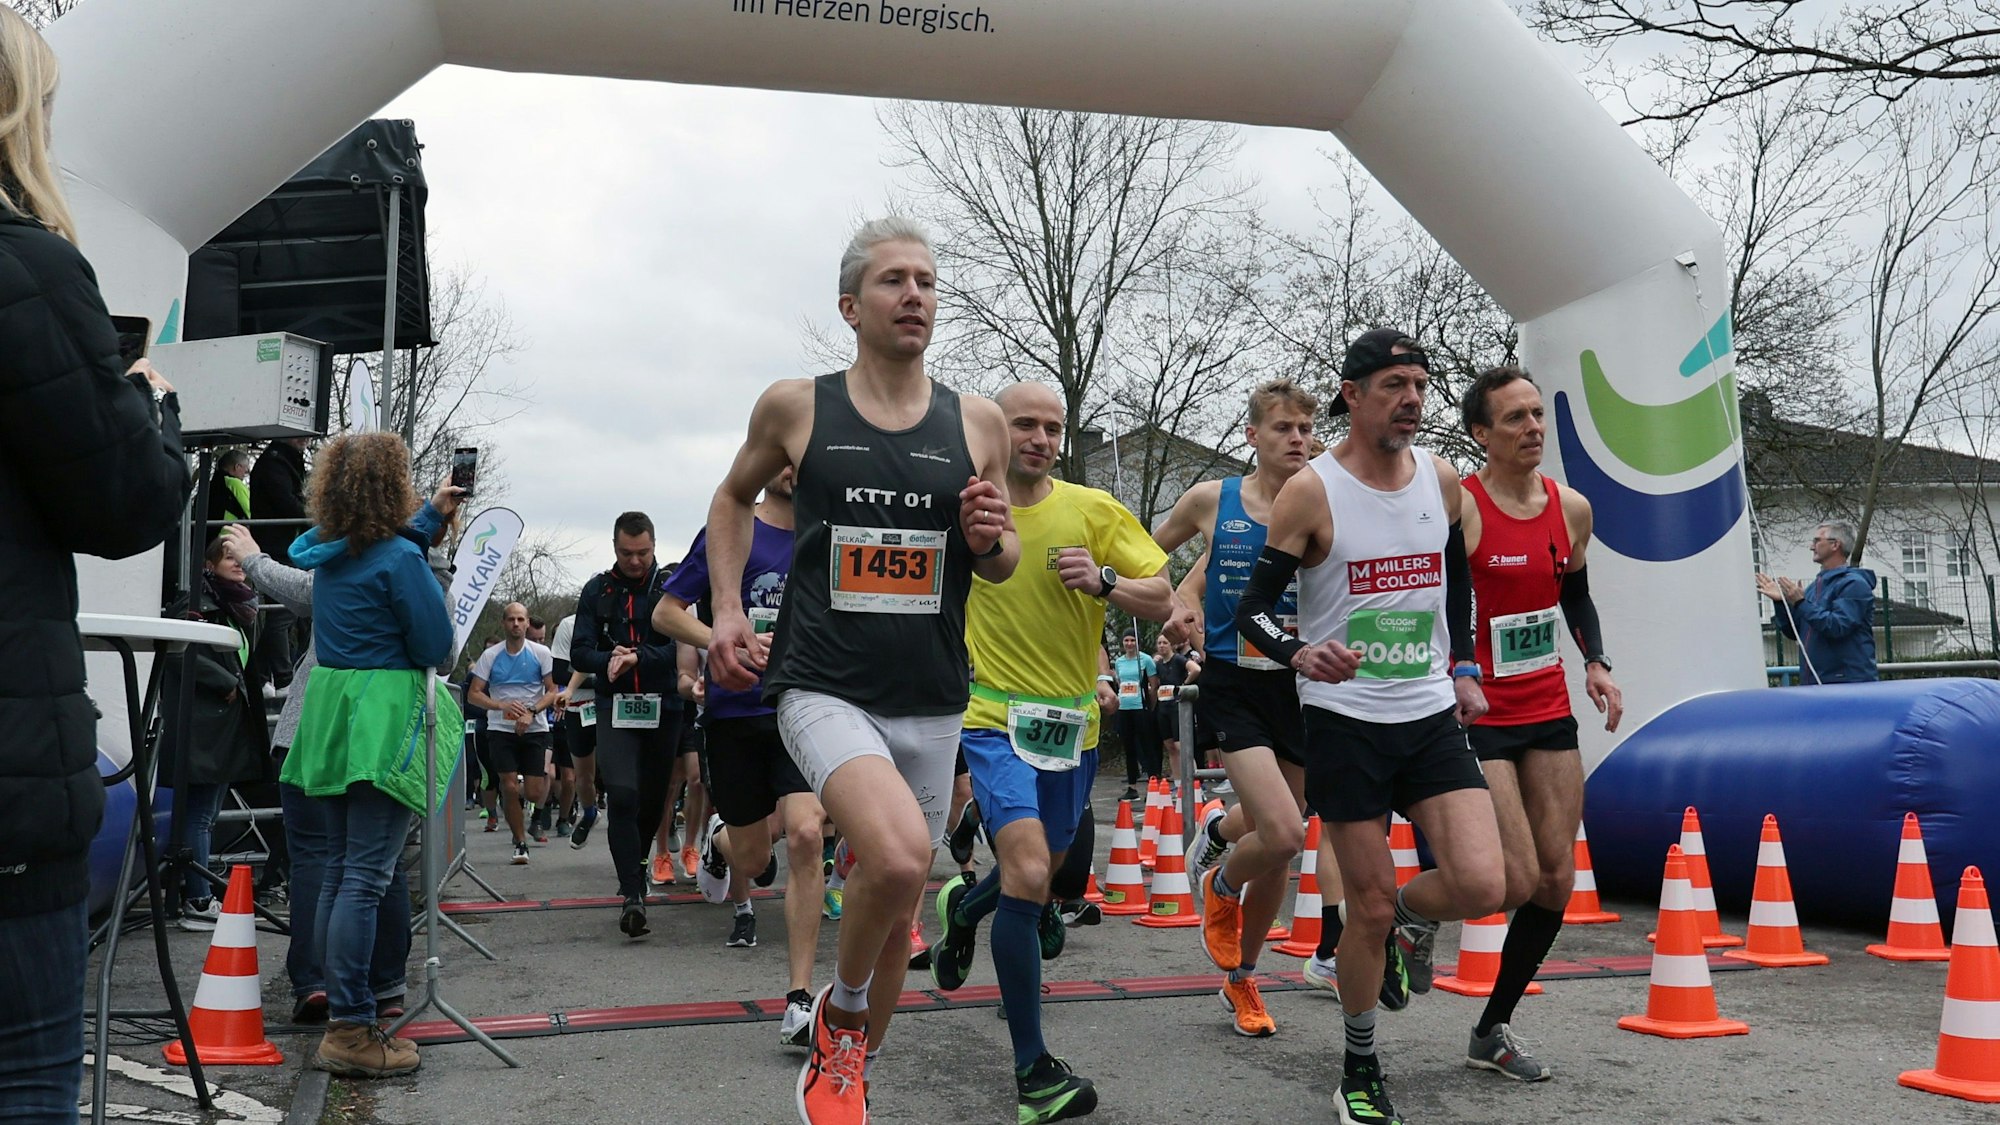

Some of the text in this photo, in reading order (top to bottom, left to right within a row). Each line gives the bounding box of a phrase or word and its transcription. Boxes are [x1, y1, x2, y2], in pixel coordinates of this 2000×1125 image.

[775, 0, 870, 22] Herzen
[879, 0, 995, 34] bergisch.
[845, 487, 933, 509] KTT 01
[837, 535, 867, 544] BELKAW
[849, 547, 928, 580] 1453
[1219, 559, 1251, 569] Cellagon
[1375, 556, 1431, 574] MILERS
[455, 546, 502, 627] BELKAW
[1376, 571, 1441, 590] COLONIA
[1380, 617, 1418, 626] COLOGNE
[1505, 623, 1552, 651] 1214
[1350, 640, 1429, 665] 20680
[624, 701, 651, 715] 585
[1026, 719, 1069, 746] 370
